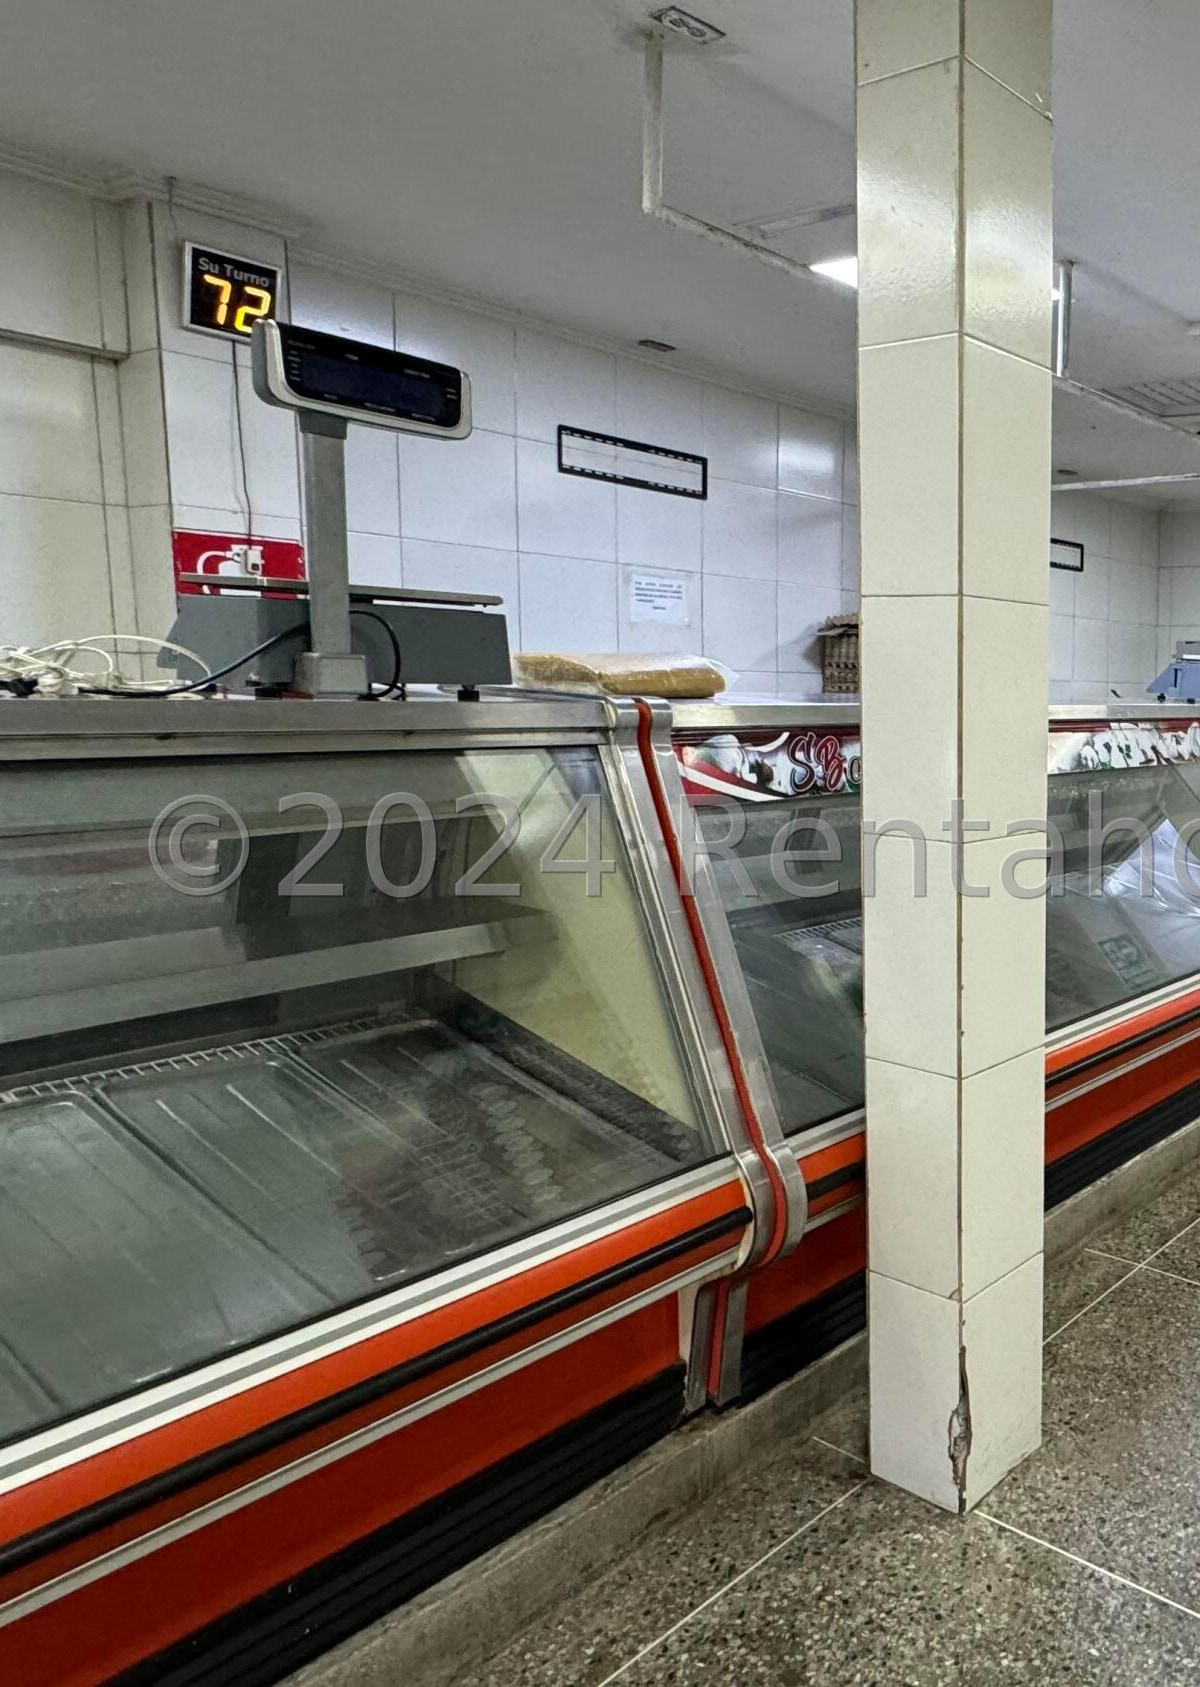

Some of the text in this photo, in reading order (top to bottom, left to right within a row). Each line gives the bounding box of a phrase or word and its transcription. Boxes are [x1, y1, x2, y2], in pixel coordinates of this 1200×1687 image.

[198, 257, 270, 288] Su Turno
[203, 274, 272, 333] 72
